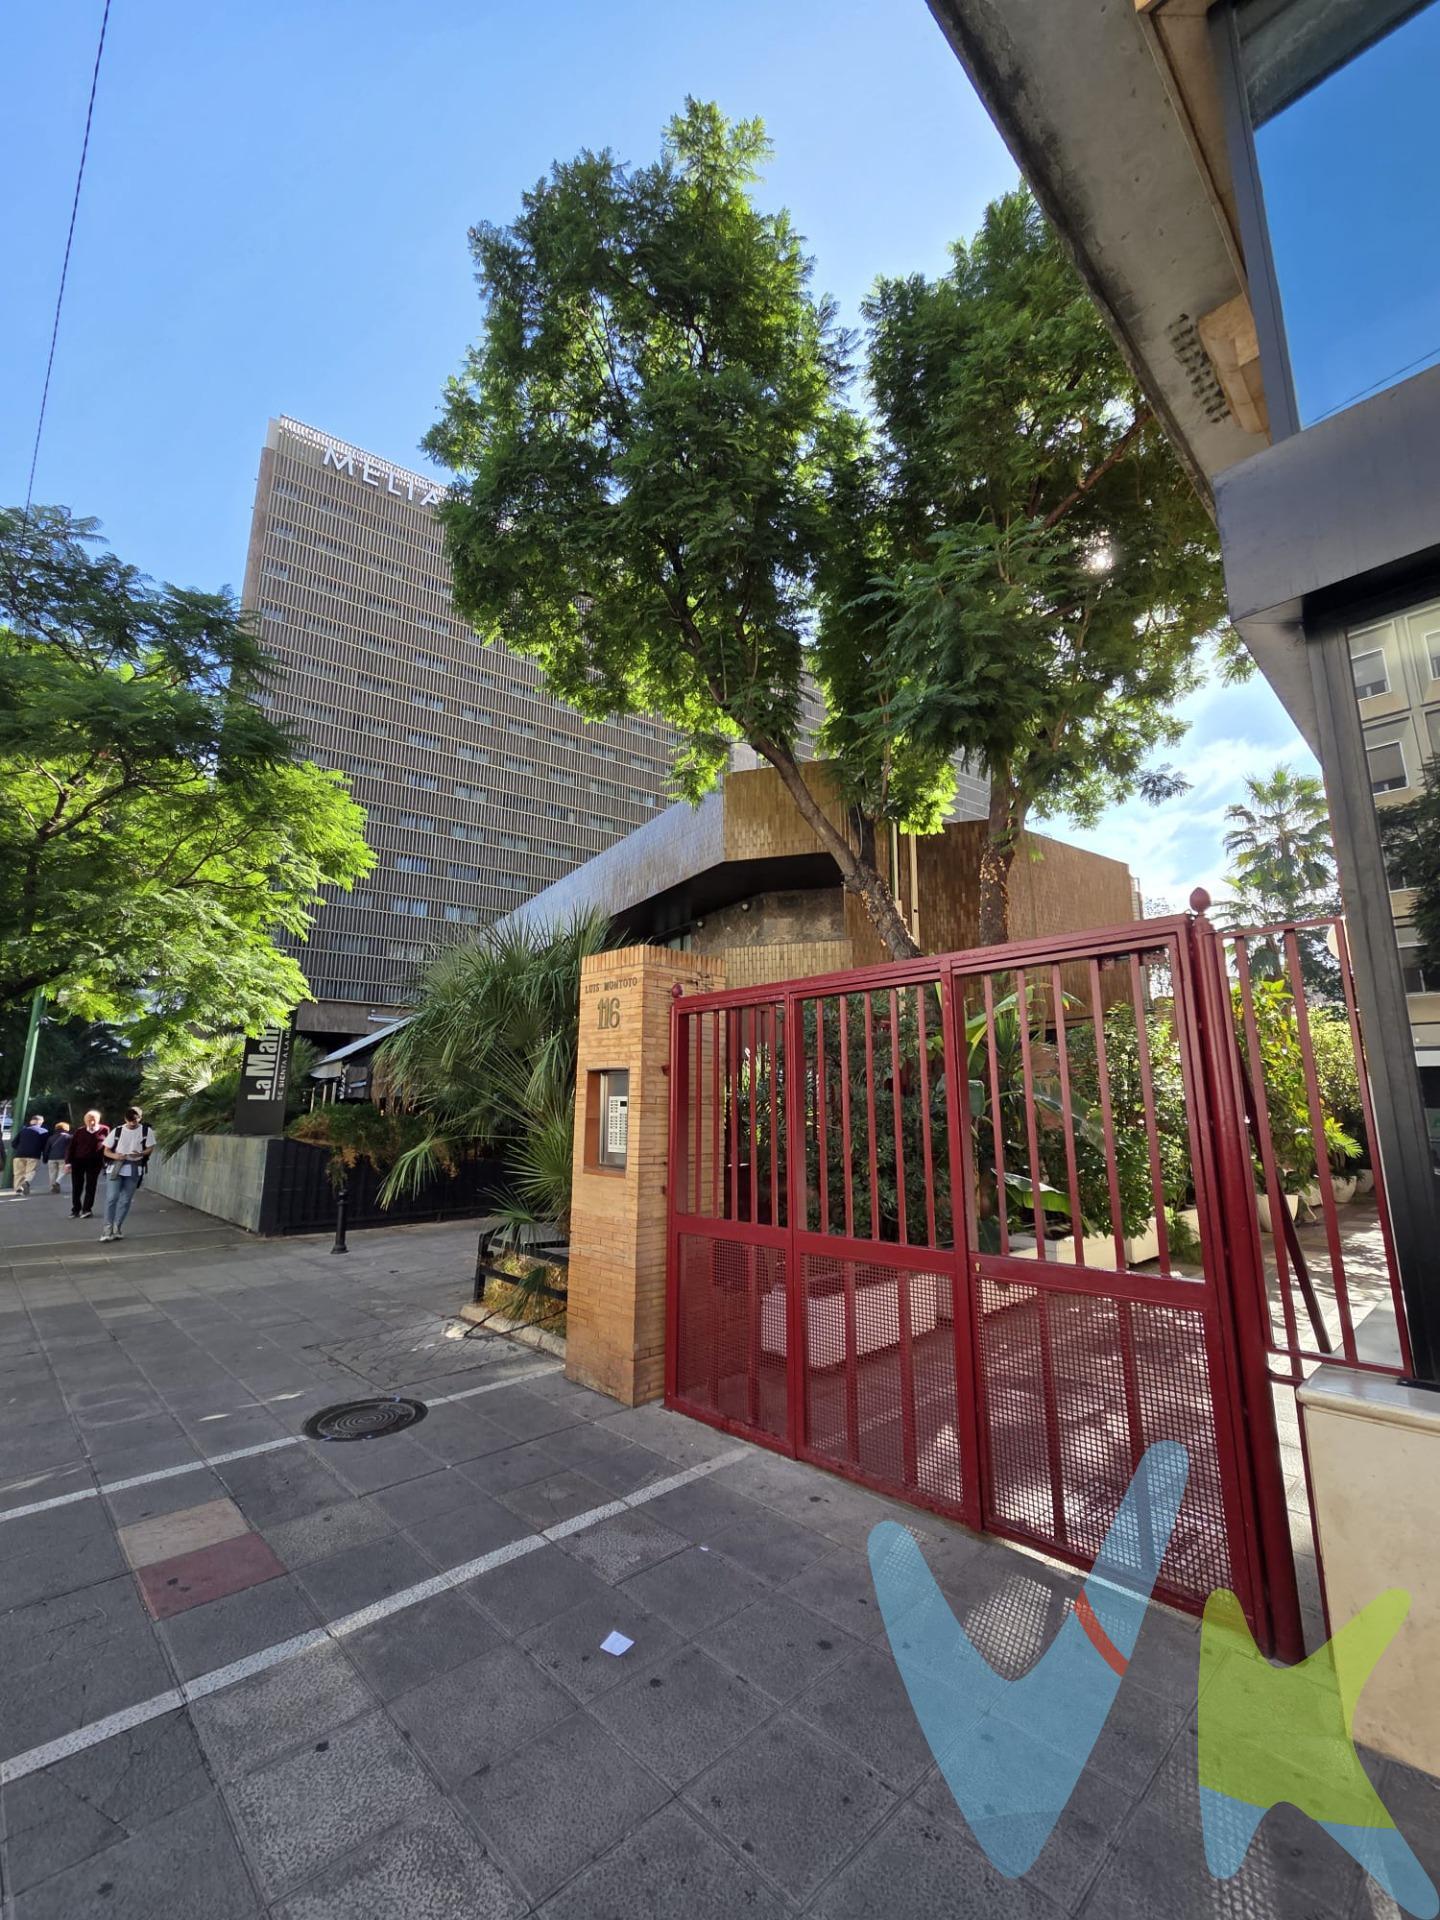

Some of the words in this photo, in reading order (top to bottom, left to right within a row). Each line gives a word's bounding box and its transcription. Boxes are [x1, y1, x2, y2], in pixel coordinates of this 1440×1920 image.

[585, 983, 599, 994] LUIS
[604, 977, 638, 991] MONTOTO
[597, 997, 620, 1030] 116
